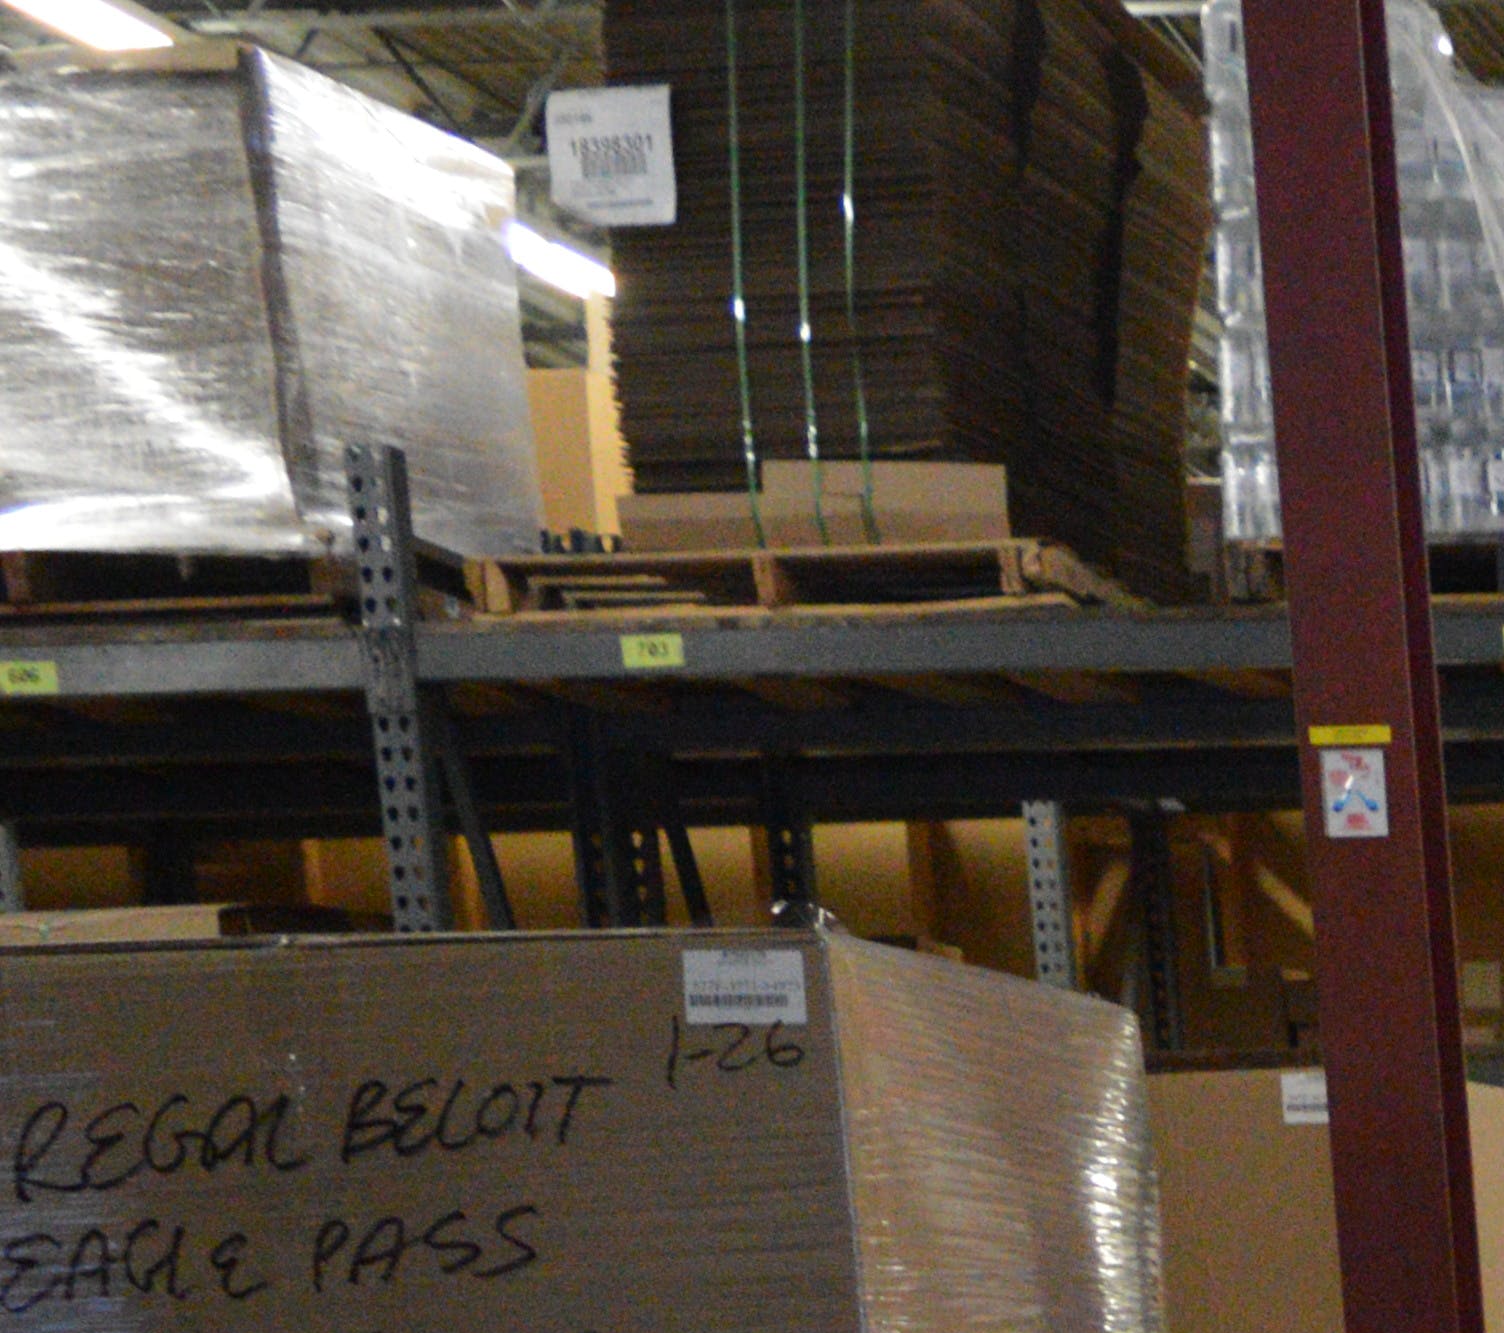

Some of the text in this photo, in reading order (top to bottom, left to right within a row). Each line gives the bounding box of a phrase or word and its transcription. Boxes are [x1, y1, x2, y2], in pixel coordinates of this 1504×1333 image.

[667, 1015, 806, 1087] 1-26
[13, 1076, 614, 1203] REGAL BELOIT
[0, 1205, 539, 1313] EAGLE PASS
